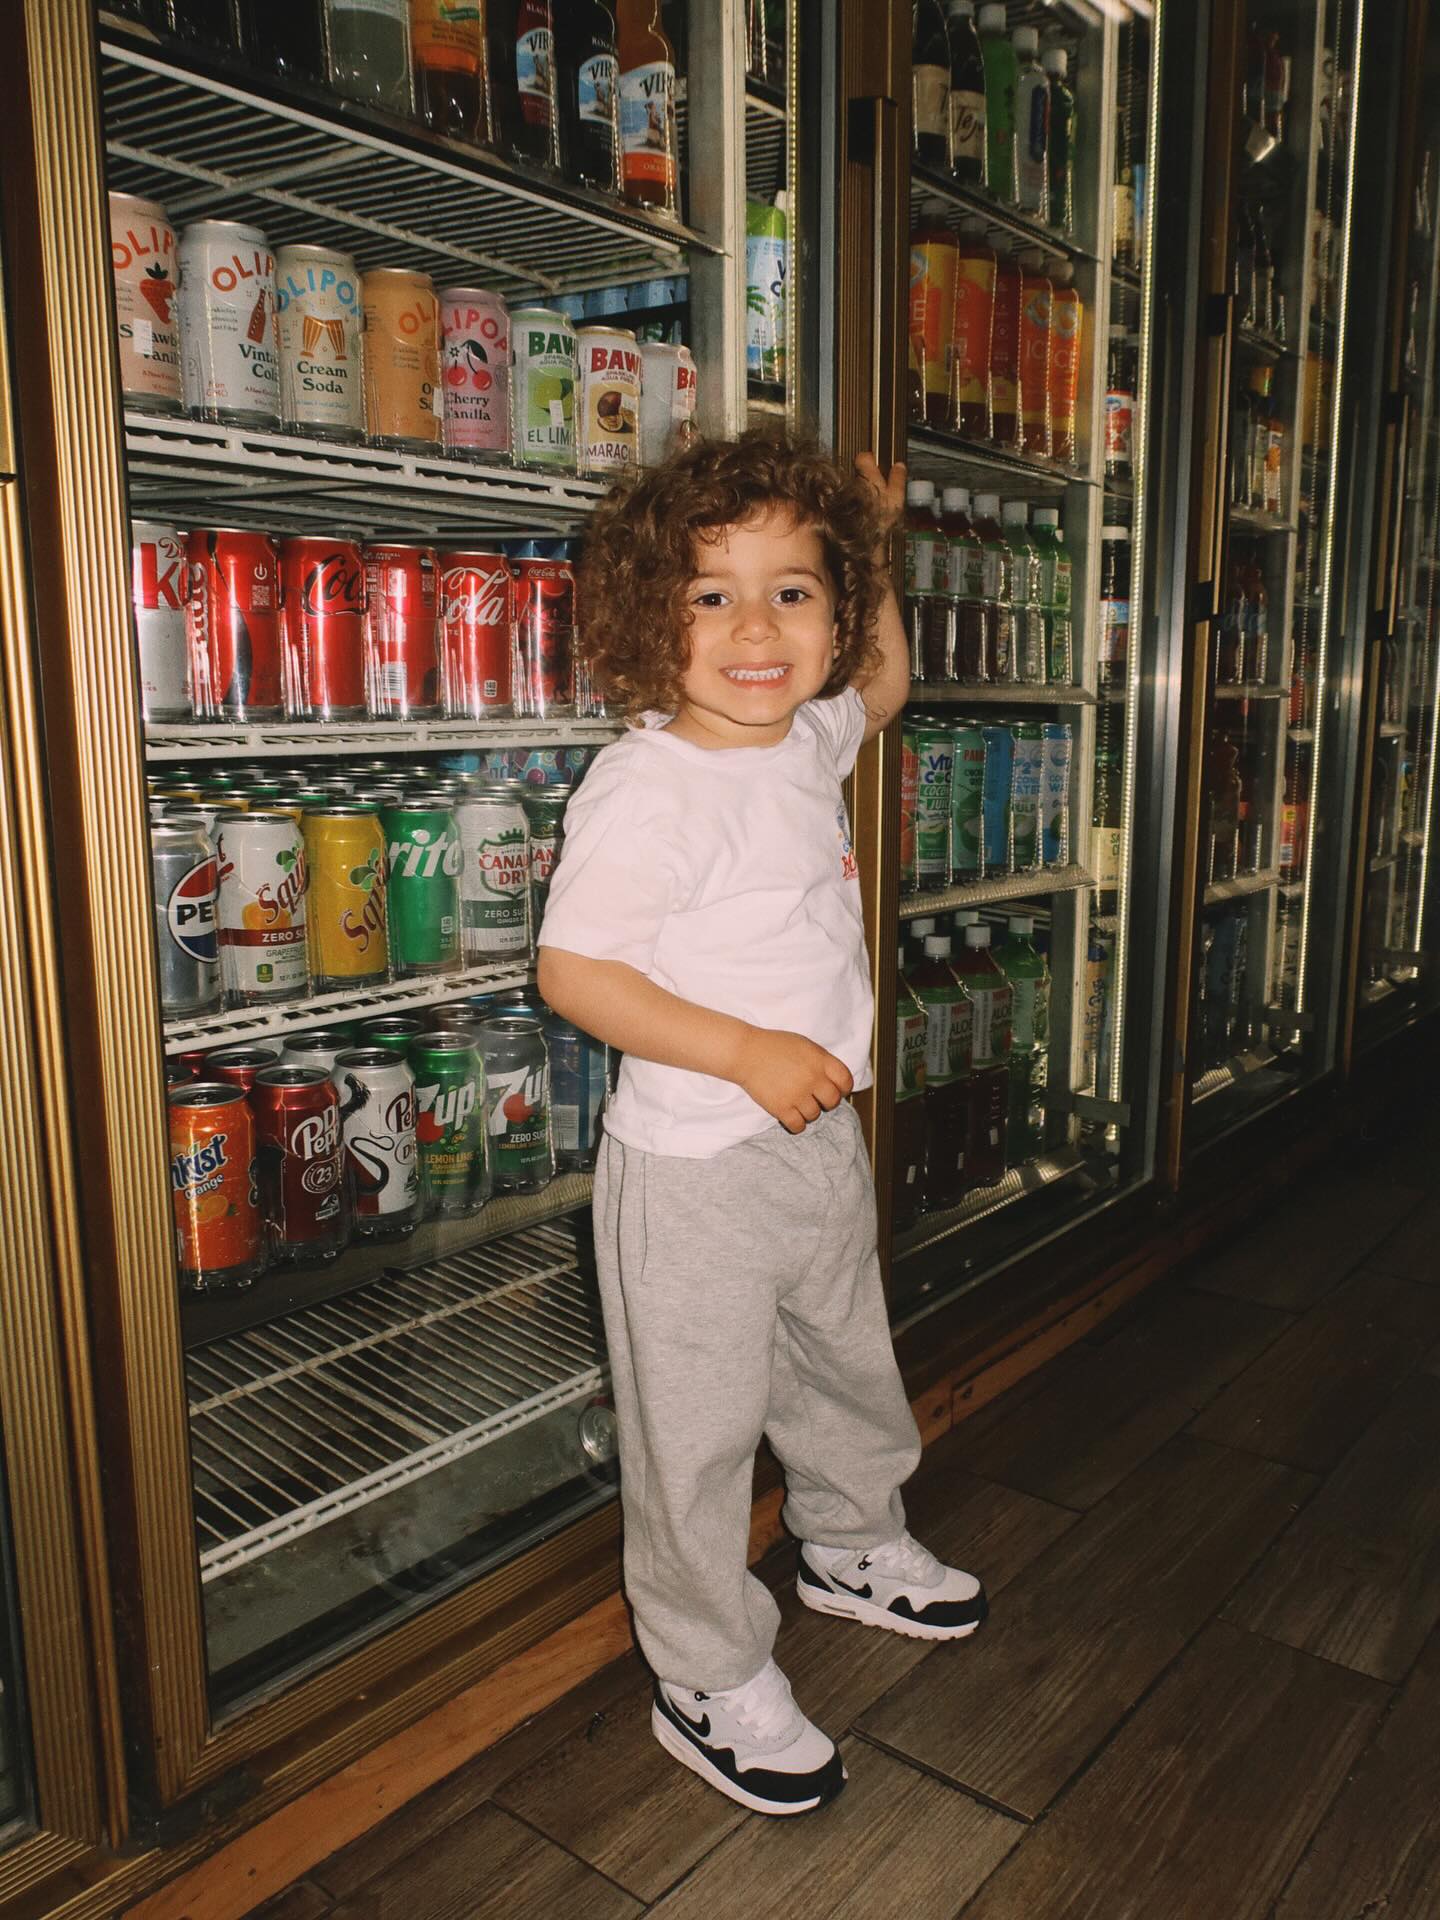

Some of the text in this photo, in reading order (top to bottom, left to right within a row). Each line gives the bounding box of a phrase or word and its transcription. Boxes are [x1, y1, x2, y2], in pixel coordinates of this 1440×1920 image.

[296, 360, 349, 379] Cream
[302, 377, 344, 395] Soda
[528, 429, 543, 444] EL
[484, 909, 510, 919] ZERO
[262, 930, 294, 943] ZERO
[510, 1131, 532, 1144] ZERO
[315, 1165, 332, 1185] 23
[184, 1173, 225, 1200] Orange
